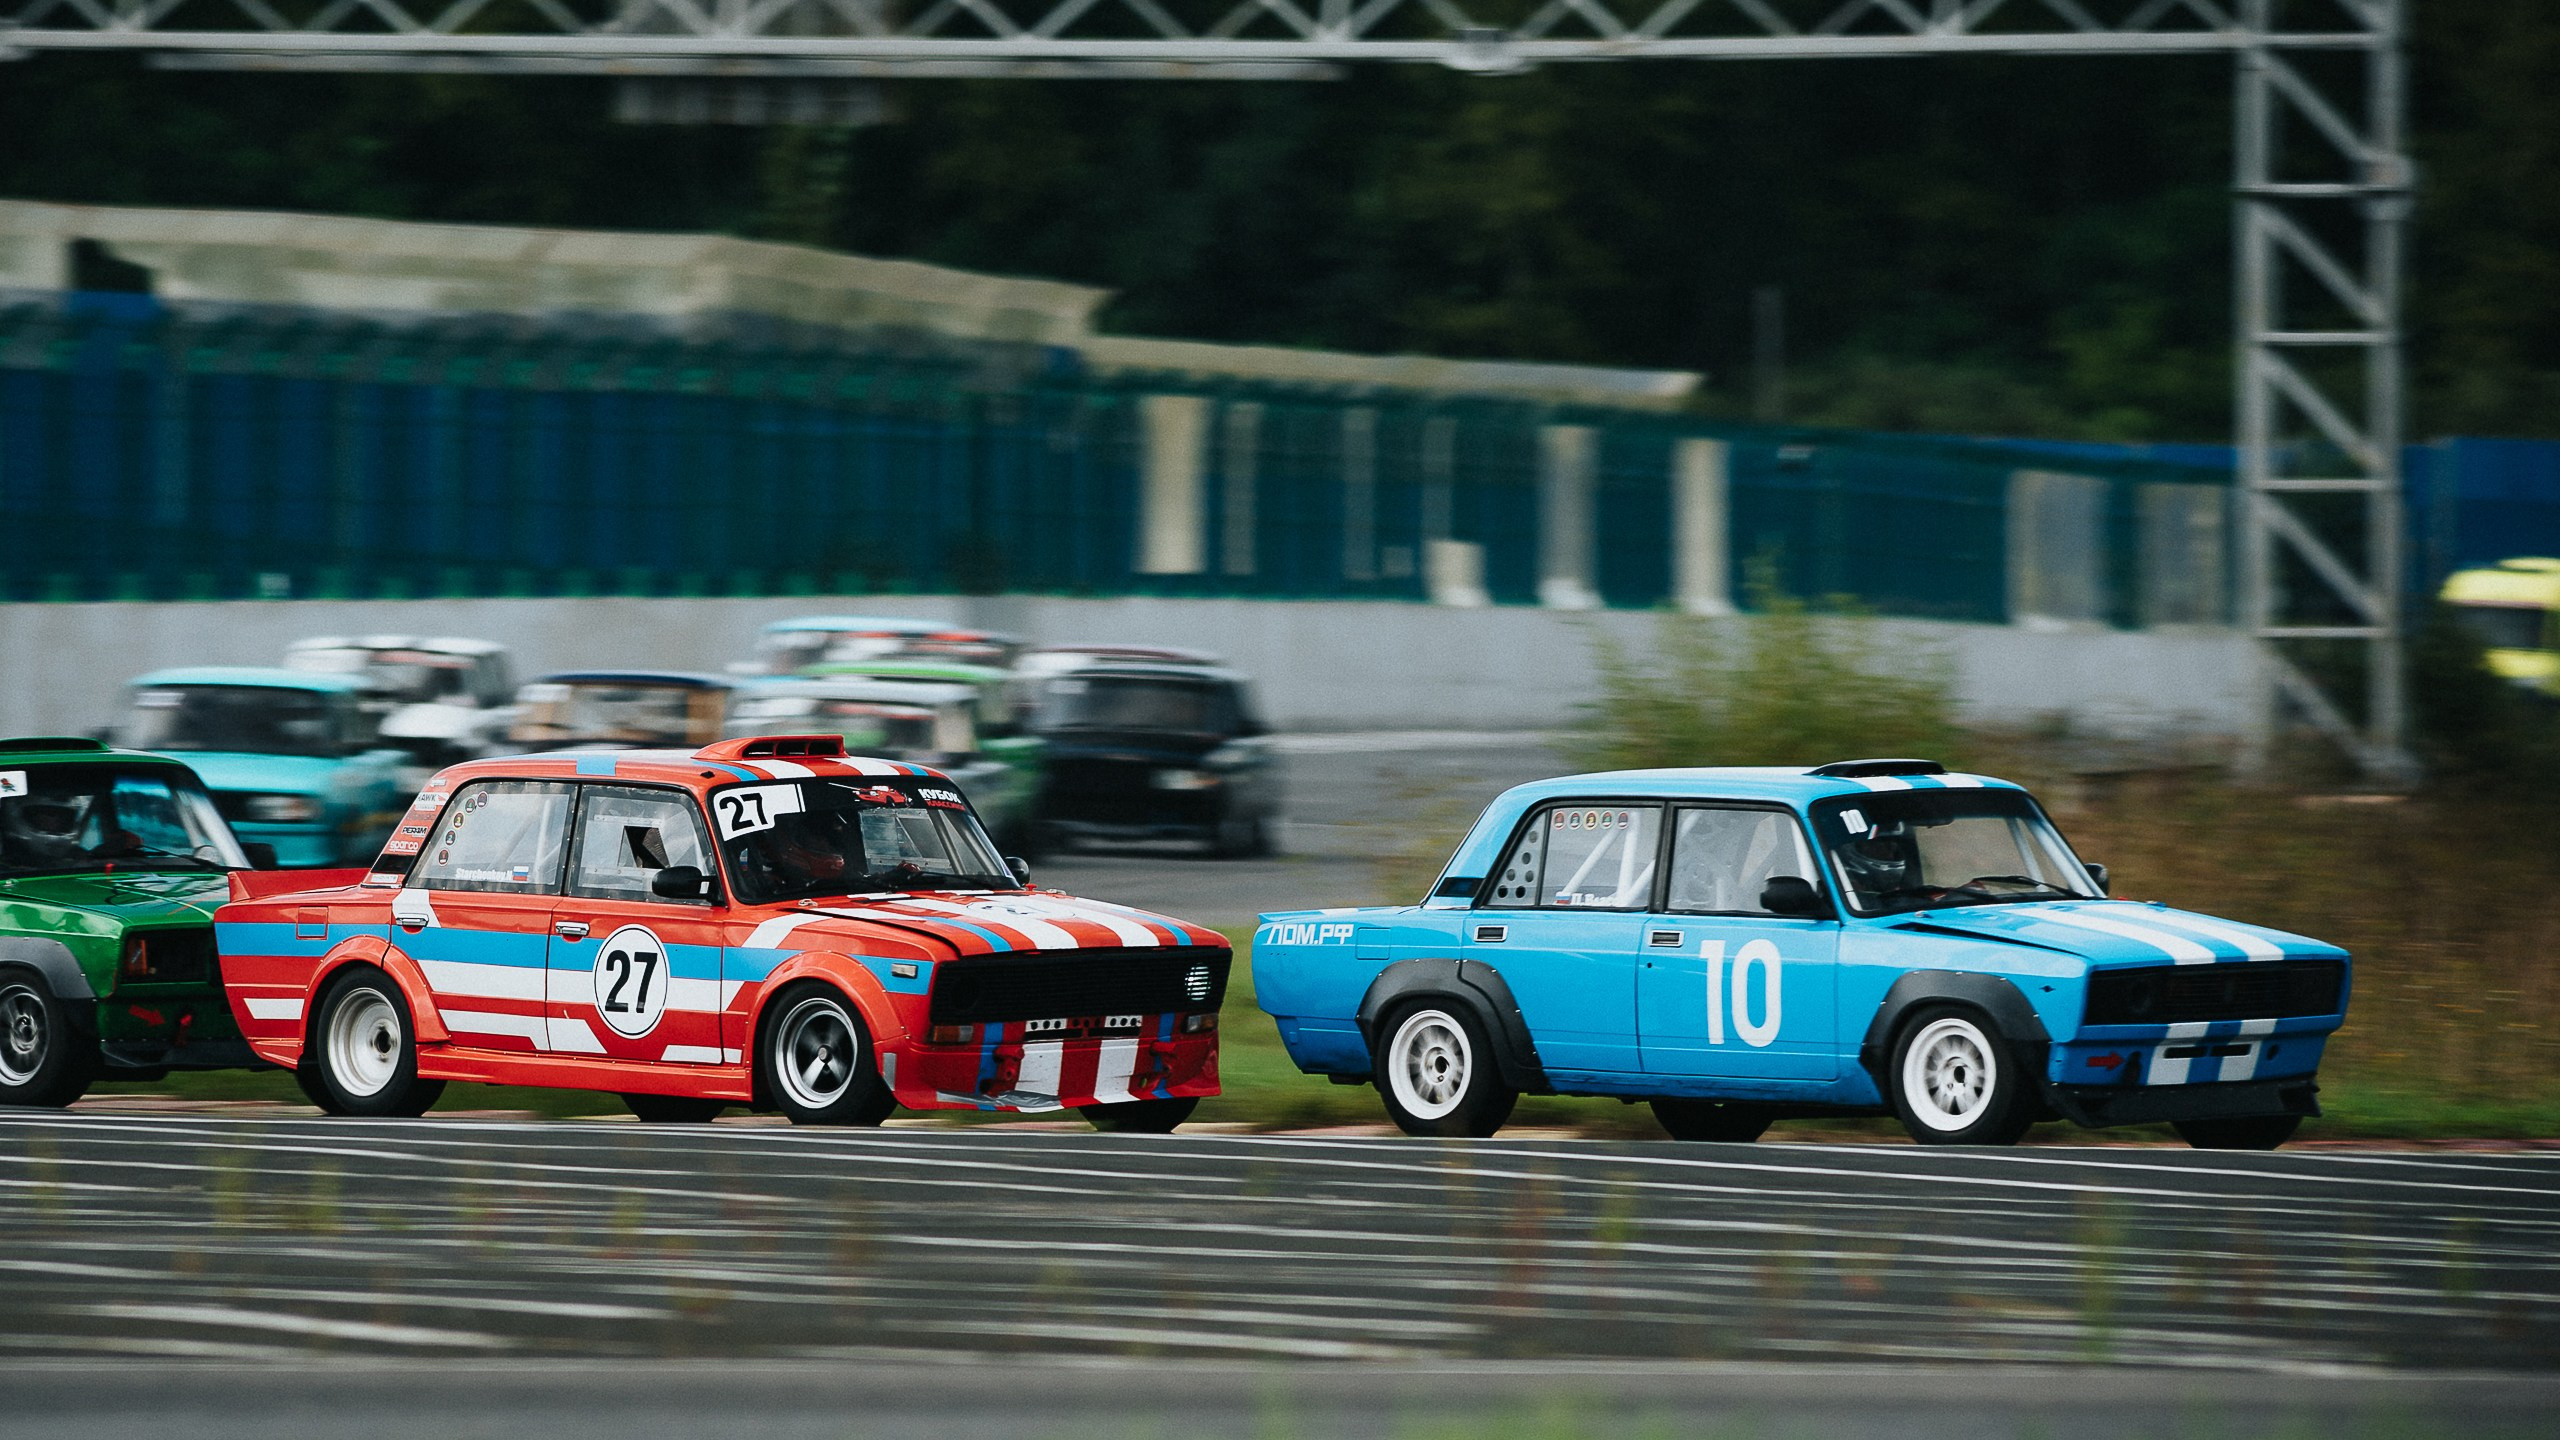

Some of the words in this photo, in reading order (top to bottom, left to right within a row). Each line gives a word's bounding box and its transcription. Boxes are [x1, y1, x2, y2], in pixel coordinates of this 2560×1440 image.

[719, 792, 769, 832] 27
[918, 789, 962, 804] КУБОК
[1839, 809, 1868, 834] 10
[390, 841, 418, 852] sparco
[604, 949, 658, 1014] 27
[1699, 939, 1782, 1048] 10
